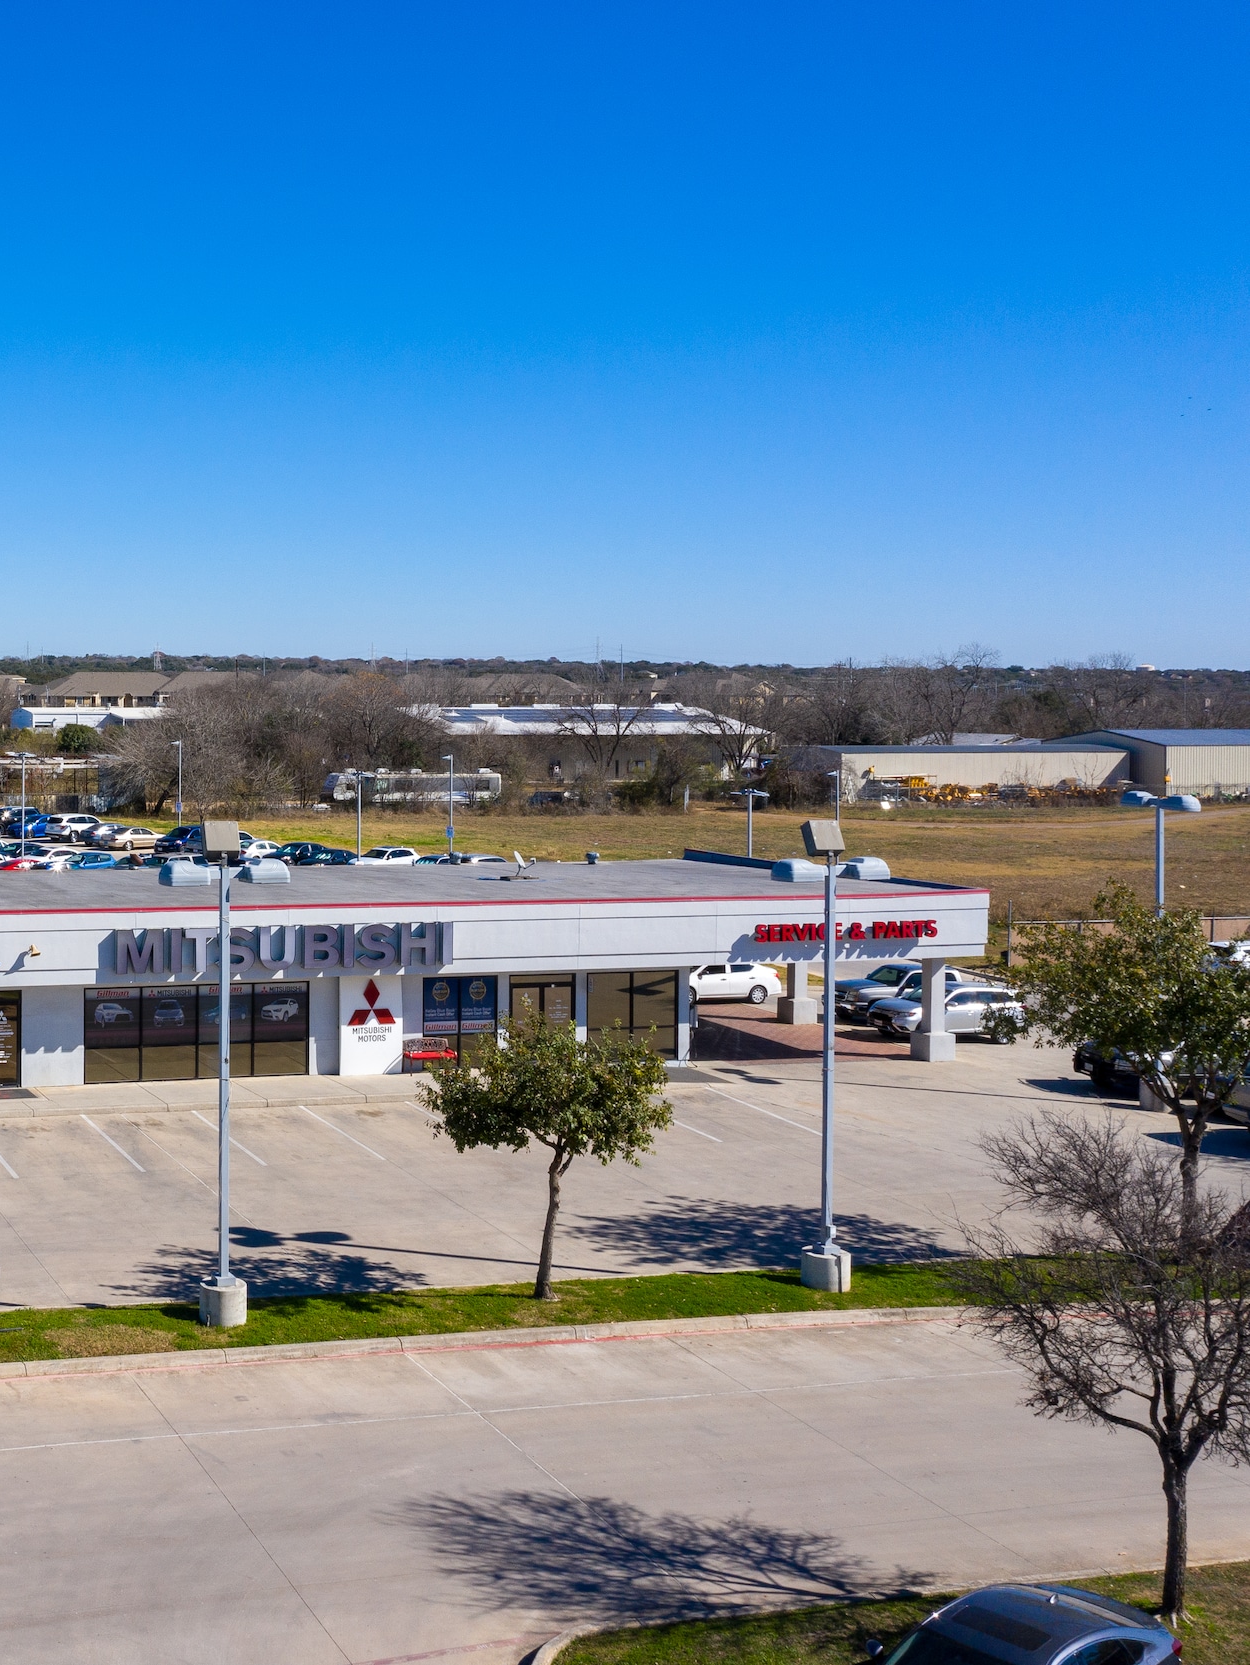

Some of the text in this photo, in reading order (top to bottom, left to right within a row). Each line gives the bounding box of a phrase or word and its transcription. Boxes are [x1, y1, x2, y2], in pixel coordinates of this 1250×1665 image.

[849, 921, 867, 941] &
[873, 919, 938, 940] PARTS
[115, 921, 453, 975] MITSUBISHI
[157, 988, 192, 997] MITSUBISHI
[269, 985, 303, 993] MITSUBISHI
[352, 1026, 392, 1035] MITSUBISHI
[357, 1034, 387, 1043] MOTORS
